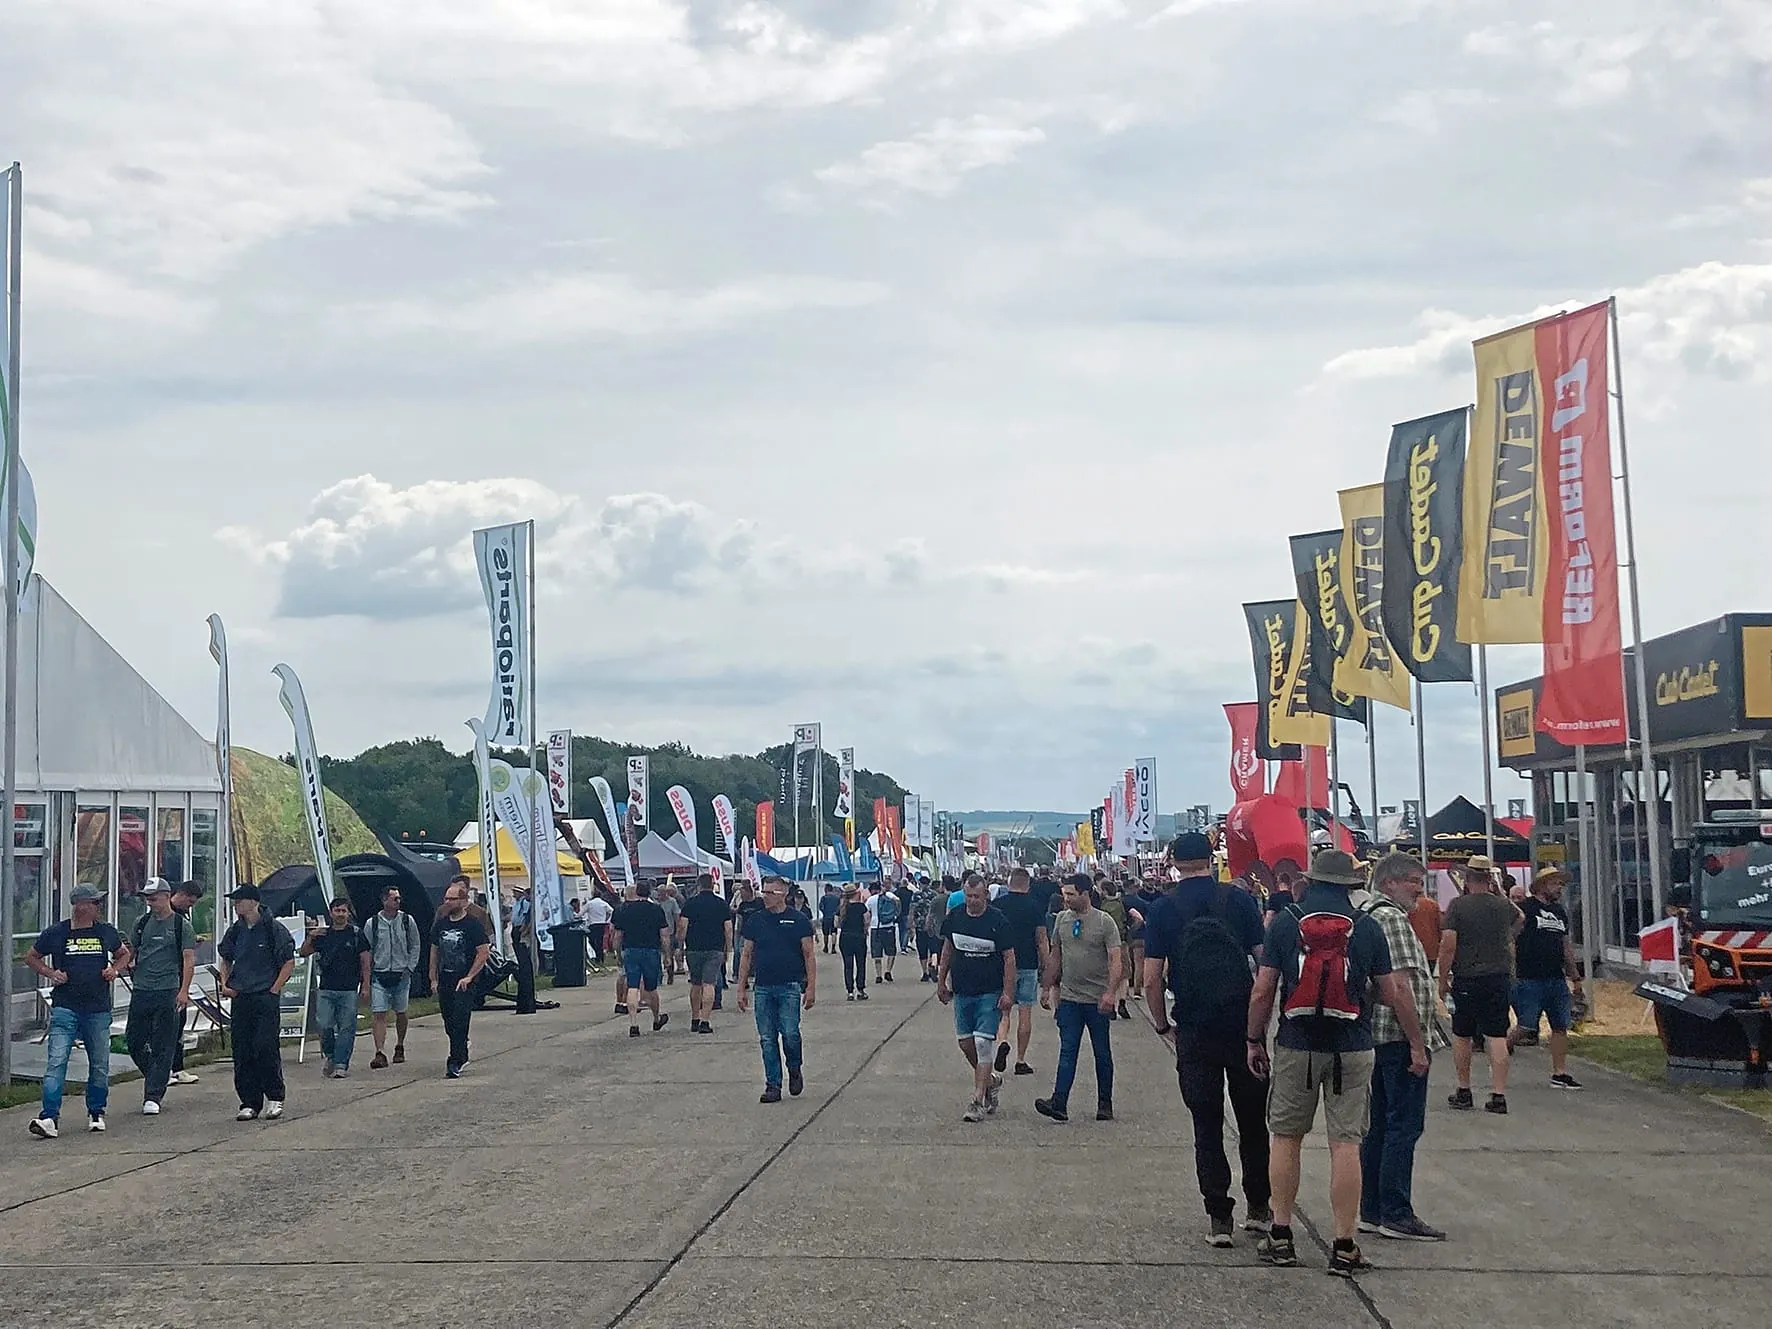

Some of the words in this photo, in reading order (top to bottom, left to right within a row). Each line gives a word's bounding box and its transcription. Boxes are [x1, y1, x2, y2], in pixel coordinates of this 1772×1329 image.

[1656, 670, 1678, 706] Cub
[1678, 659, 1720, 701] Cadet
[1432, 832, 1464, 840] Cub
[1737, 893, 1769, 908] mehr
